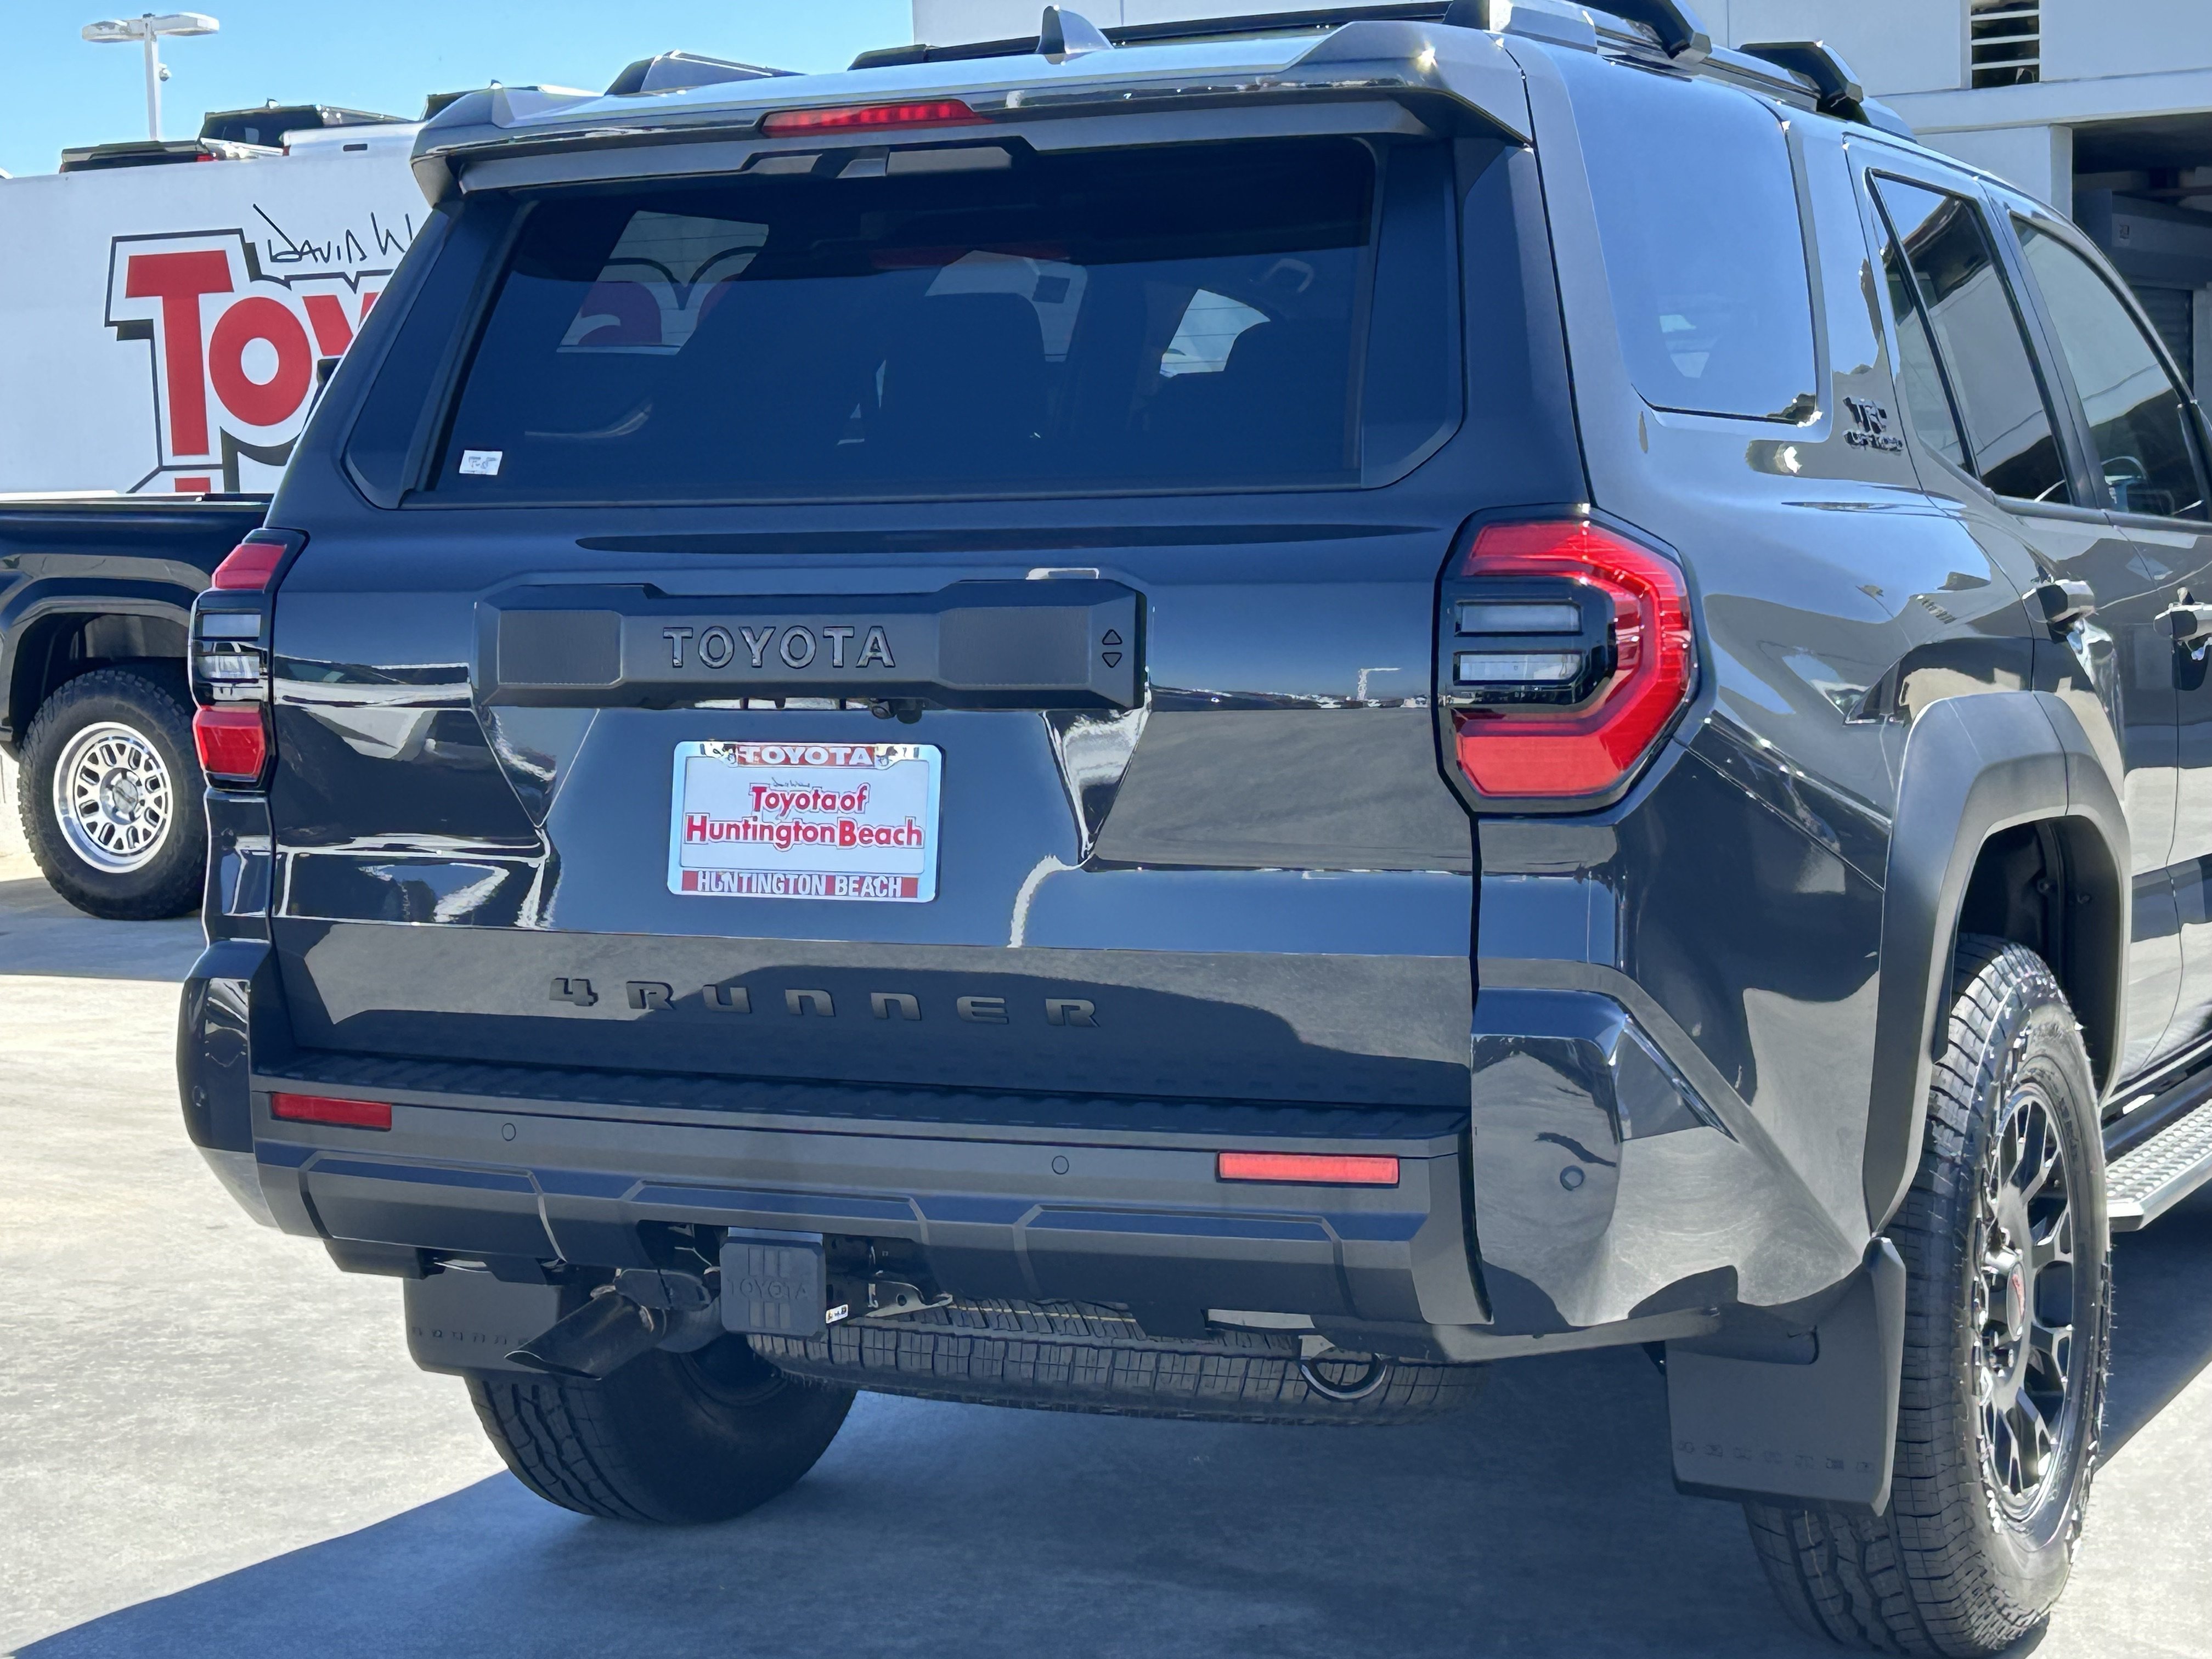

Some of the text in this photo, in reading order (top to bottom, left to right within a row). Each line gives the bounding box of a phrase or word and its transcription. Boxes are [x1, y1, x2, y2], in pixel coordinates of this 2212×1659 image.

[662, 625, 896, 669] TOYOTA
[740, 746, 873, 765] TOYOTA
[752, 785, 867, 816] Toyota of
[686, 815, 922, 849] Huntington Beach
[697, 870, 902, 898] HUNTINGTON BEACH
[549, 978, 1101, 1028] 4RUNNER
